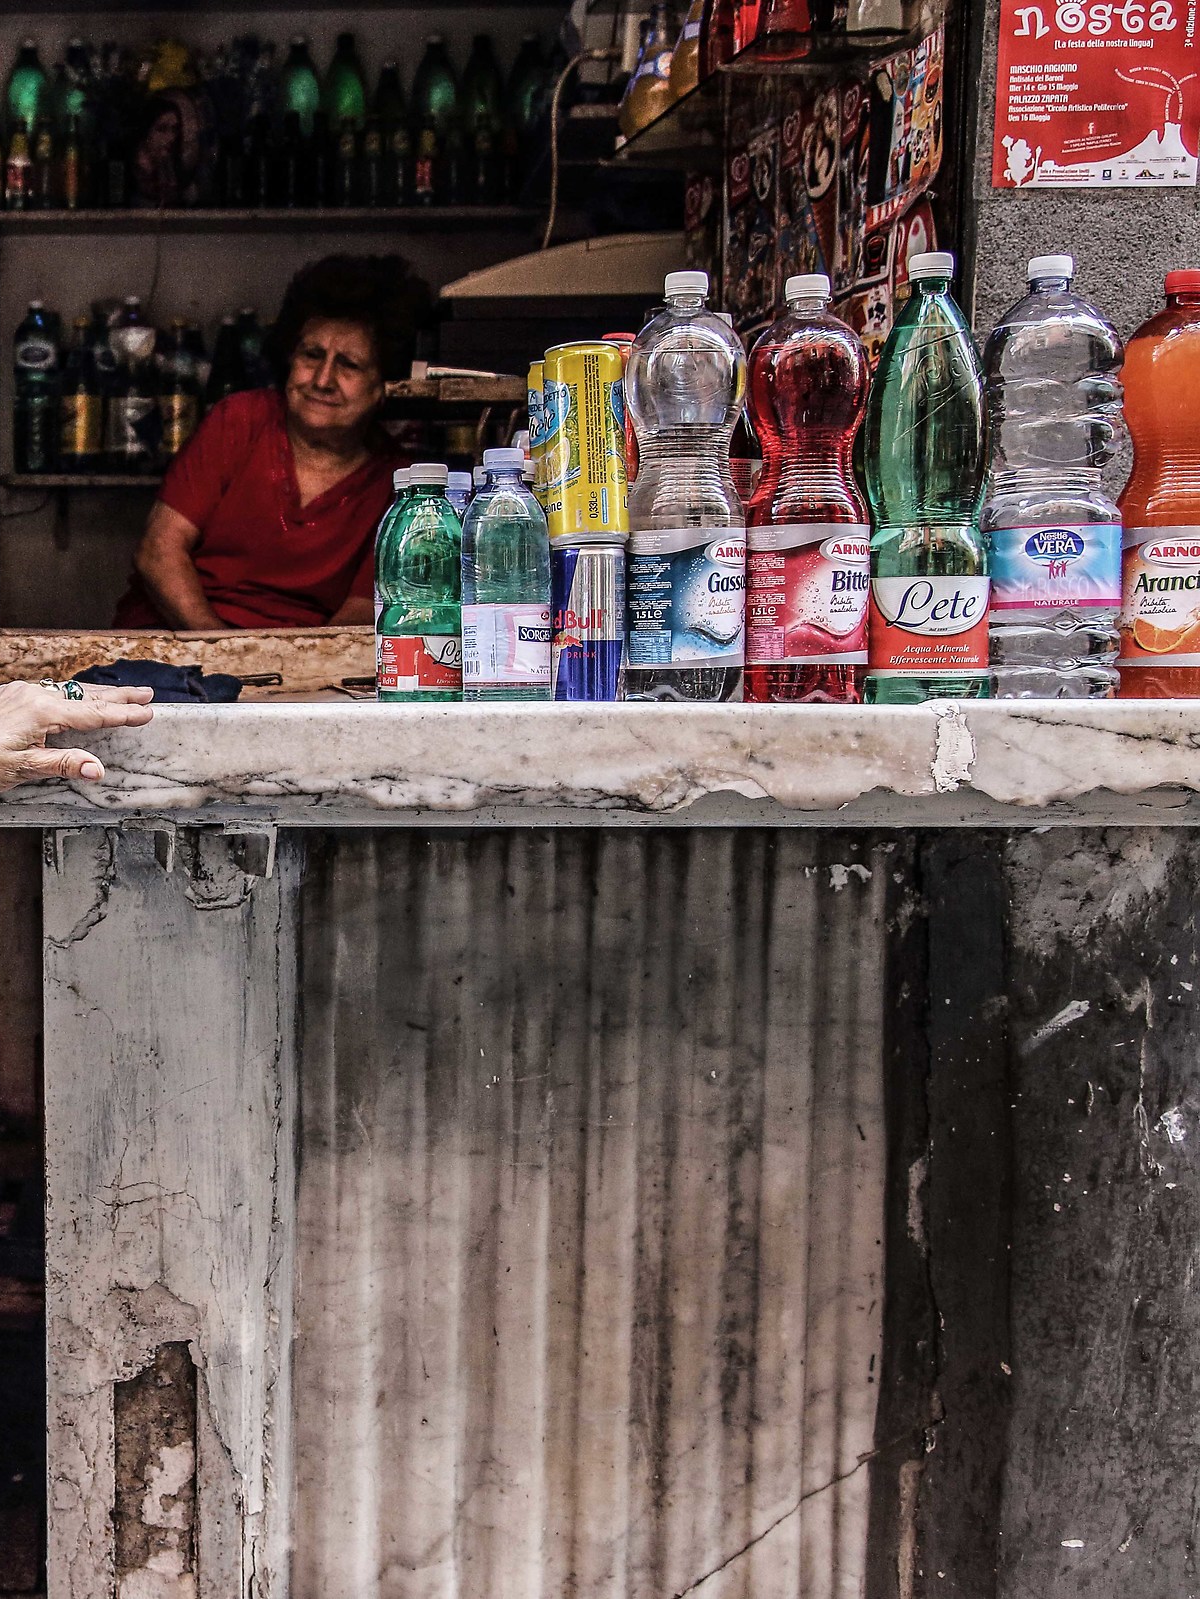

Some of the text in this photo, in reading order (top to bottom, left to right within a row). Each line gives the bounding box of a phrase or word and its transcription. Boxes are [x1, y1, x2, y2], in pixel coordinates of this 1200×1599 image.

[1186, 7, 1195, 37] edizione
[1067, 39, 1085, 48] festa
[1087, 39, 1104, 48] della
[1105, 39, 1128, 48] nostra
[1010, 65, 1043, 74] MASCHIO
[1056, 83, 1078, 91] Maggio
[1009, 94, 1068, 103] PALAZZO ZAPATA
[1034, 537, 1078, 554] VERA
[885, 580, 976, 627] Lete
[1034, 599, 1079, 607] NATURALE
[565, 608, 602, 629] Bull
[903, 643, 970, 654] Acqua Minerale
[889, 655, 979, 665] Effervescente Naturale
